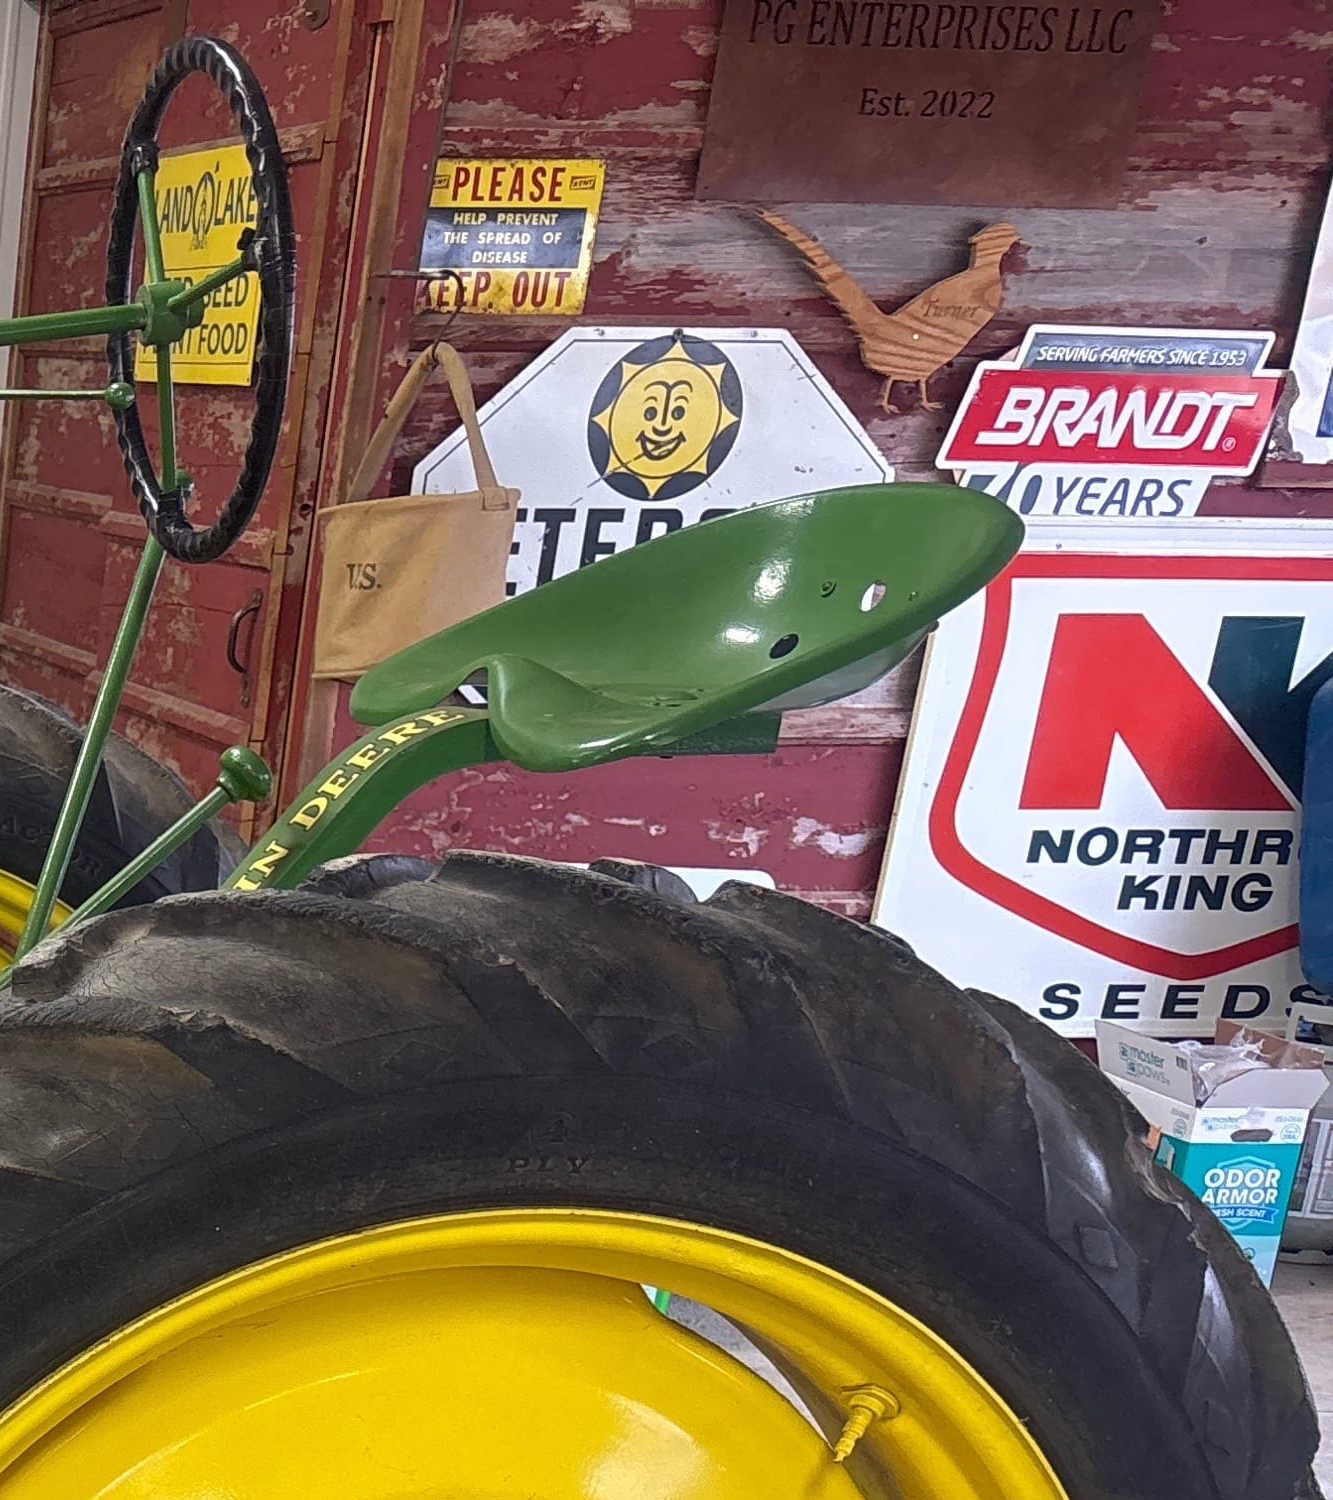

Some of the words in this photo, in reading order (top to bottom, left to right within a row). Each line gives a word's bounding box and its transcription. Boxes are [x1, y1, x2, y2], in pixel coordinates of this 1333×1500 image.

[748, 0, 797, 45] PG
[807, 0, 1060, 53] ENTERPRISES
[1065, 8, 1133, 54] LLC
[859, 88, 910, 118] Est.
[919, 90, 996, 119] 2022
[452, 166, 567, 203] PLEASE
[453, 212, 487, 225] HELP
[497, 213, 558, 226] PREVENT
[443, 231, 469, 244] THE
[477, 231, 531, 245] SPREAD
[542, 231, 562, 244] OF
[471, 250, 528, 264] DISEASE
[512, 271, 571, 308] OUT
[921, 298, 981, 318] Turner
[197, 322, 248, 355] FOOD
[1036, 345, 1099, 363] SERVING
[1098, 346, 1168, 364] FARMERS
[1166, 349, 1209, 366] SINCE
[1209, 350, 1247, 367] 1953
[974, 385, 1258, 451] BRANDT
[1052, 475, 1193, 517] YEARS
[289, 709, 466, 831] DEERE
[1026, 826, 1299, 867] NORTHR
[1116, 872, 1274, 912] KING
[1204, 1168, 1281, 1188] ODOR
[1201, 1188, 1278, 1205] ARMOR
[1235, 1208, 1266, 1218] SCENT
